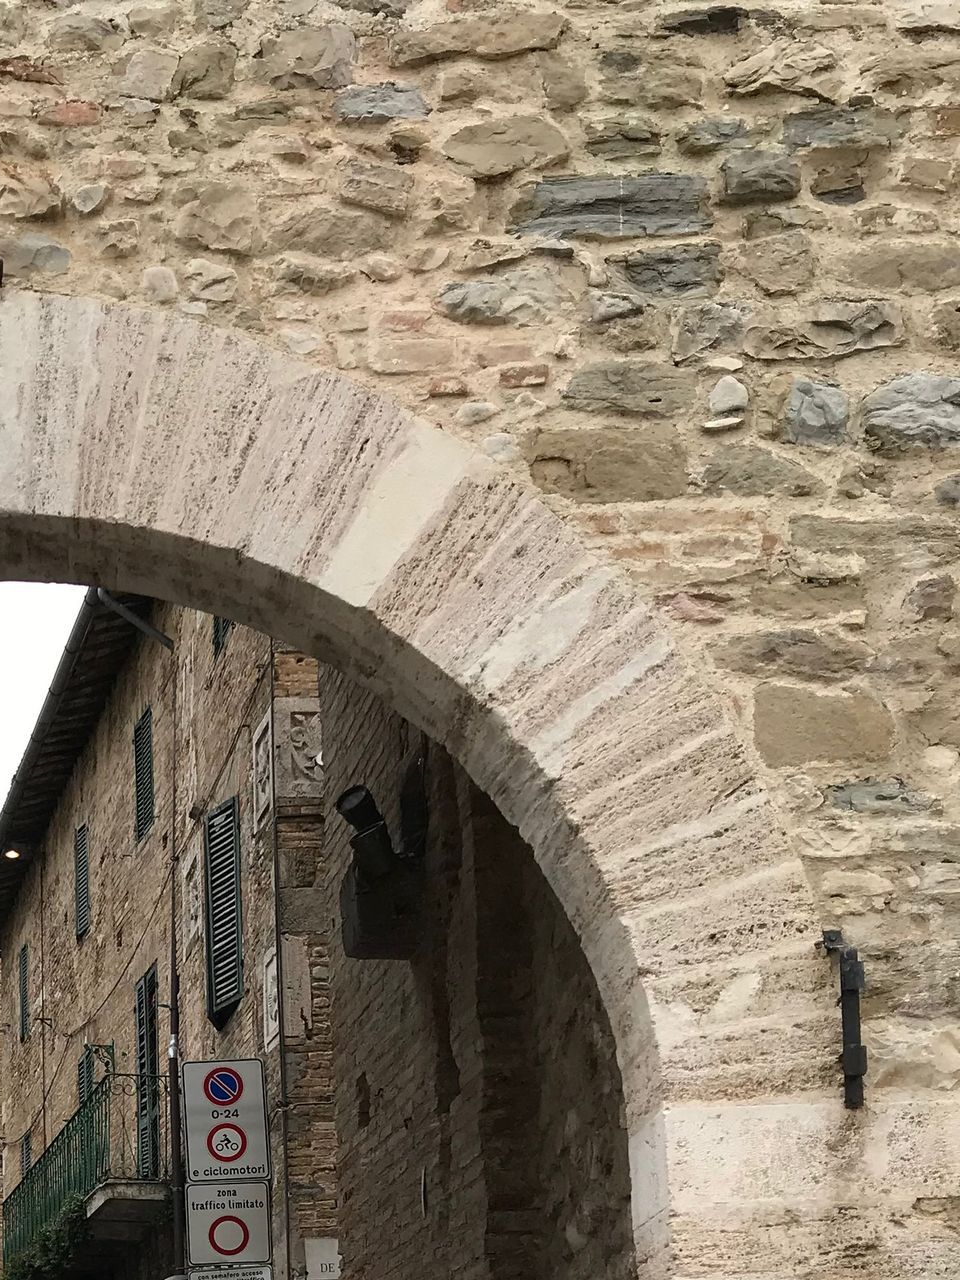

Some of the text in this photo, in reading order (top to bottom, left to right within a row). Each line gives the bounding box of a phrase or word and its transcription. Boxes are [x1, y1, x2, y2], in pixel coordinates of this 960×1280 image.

[211, 1108, 240, 1119] 0-24
[192, 1163, 266, 1177] e ciclomotori
[217, 1189, 237, 1198] zona
[191, 1199, 264, 1211] traffico limitato
[320, 1262, 335, 1273] DE
[211, 1271, 240, 1280] semaforo
